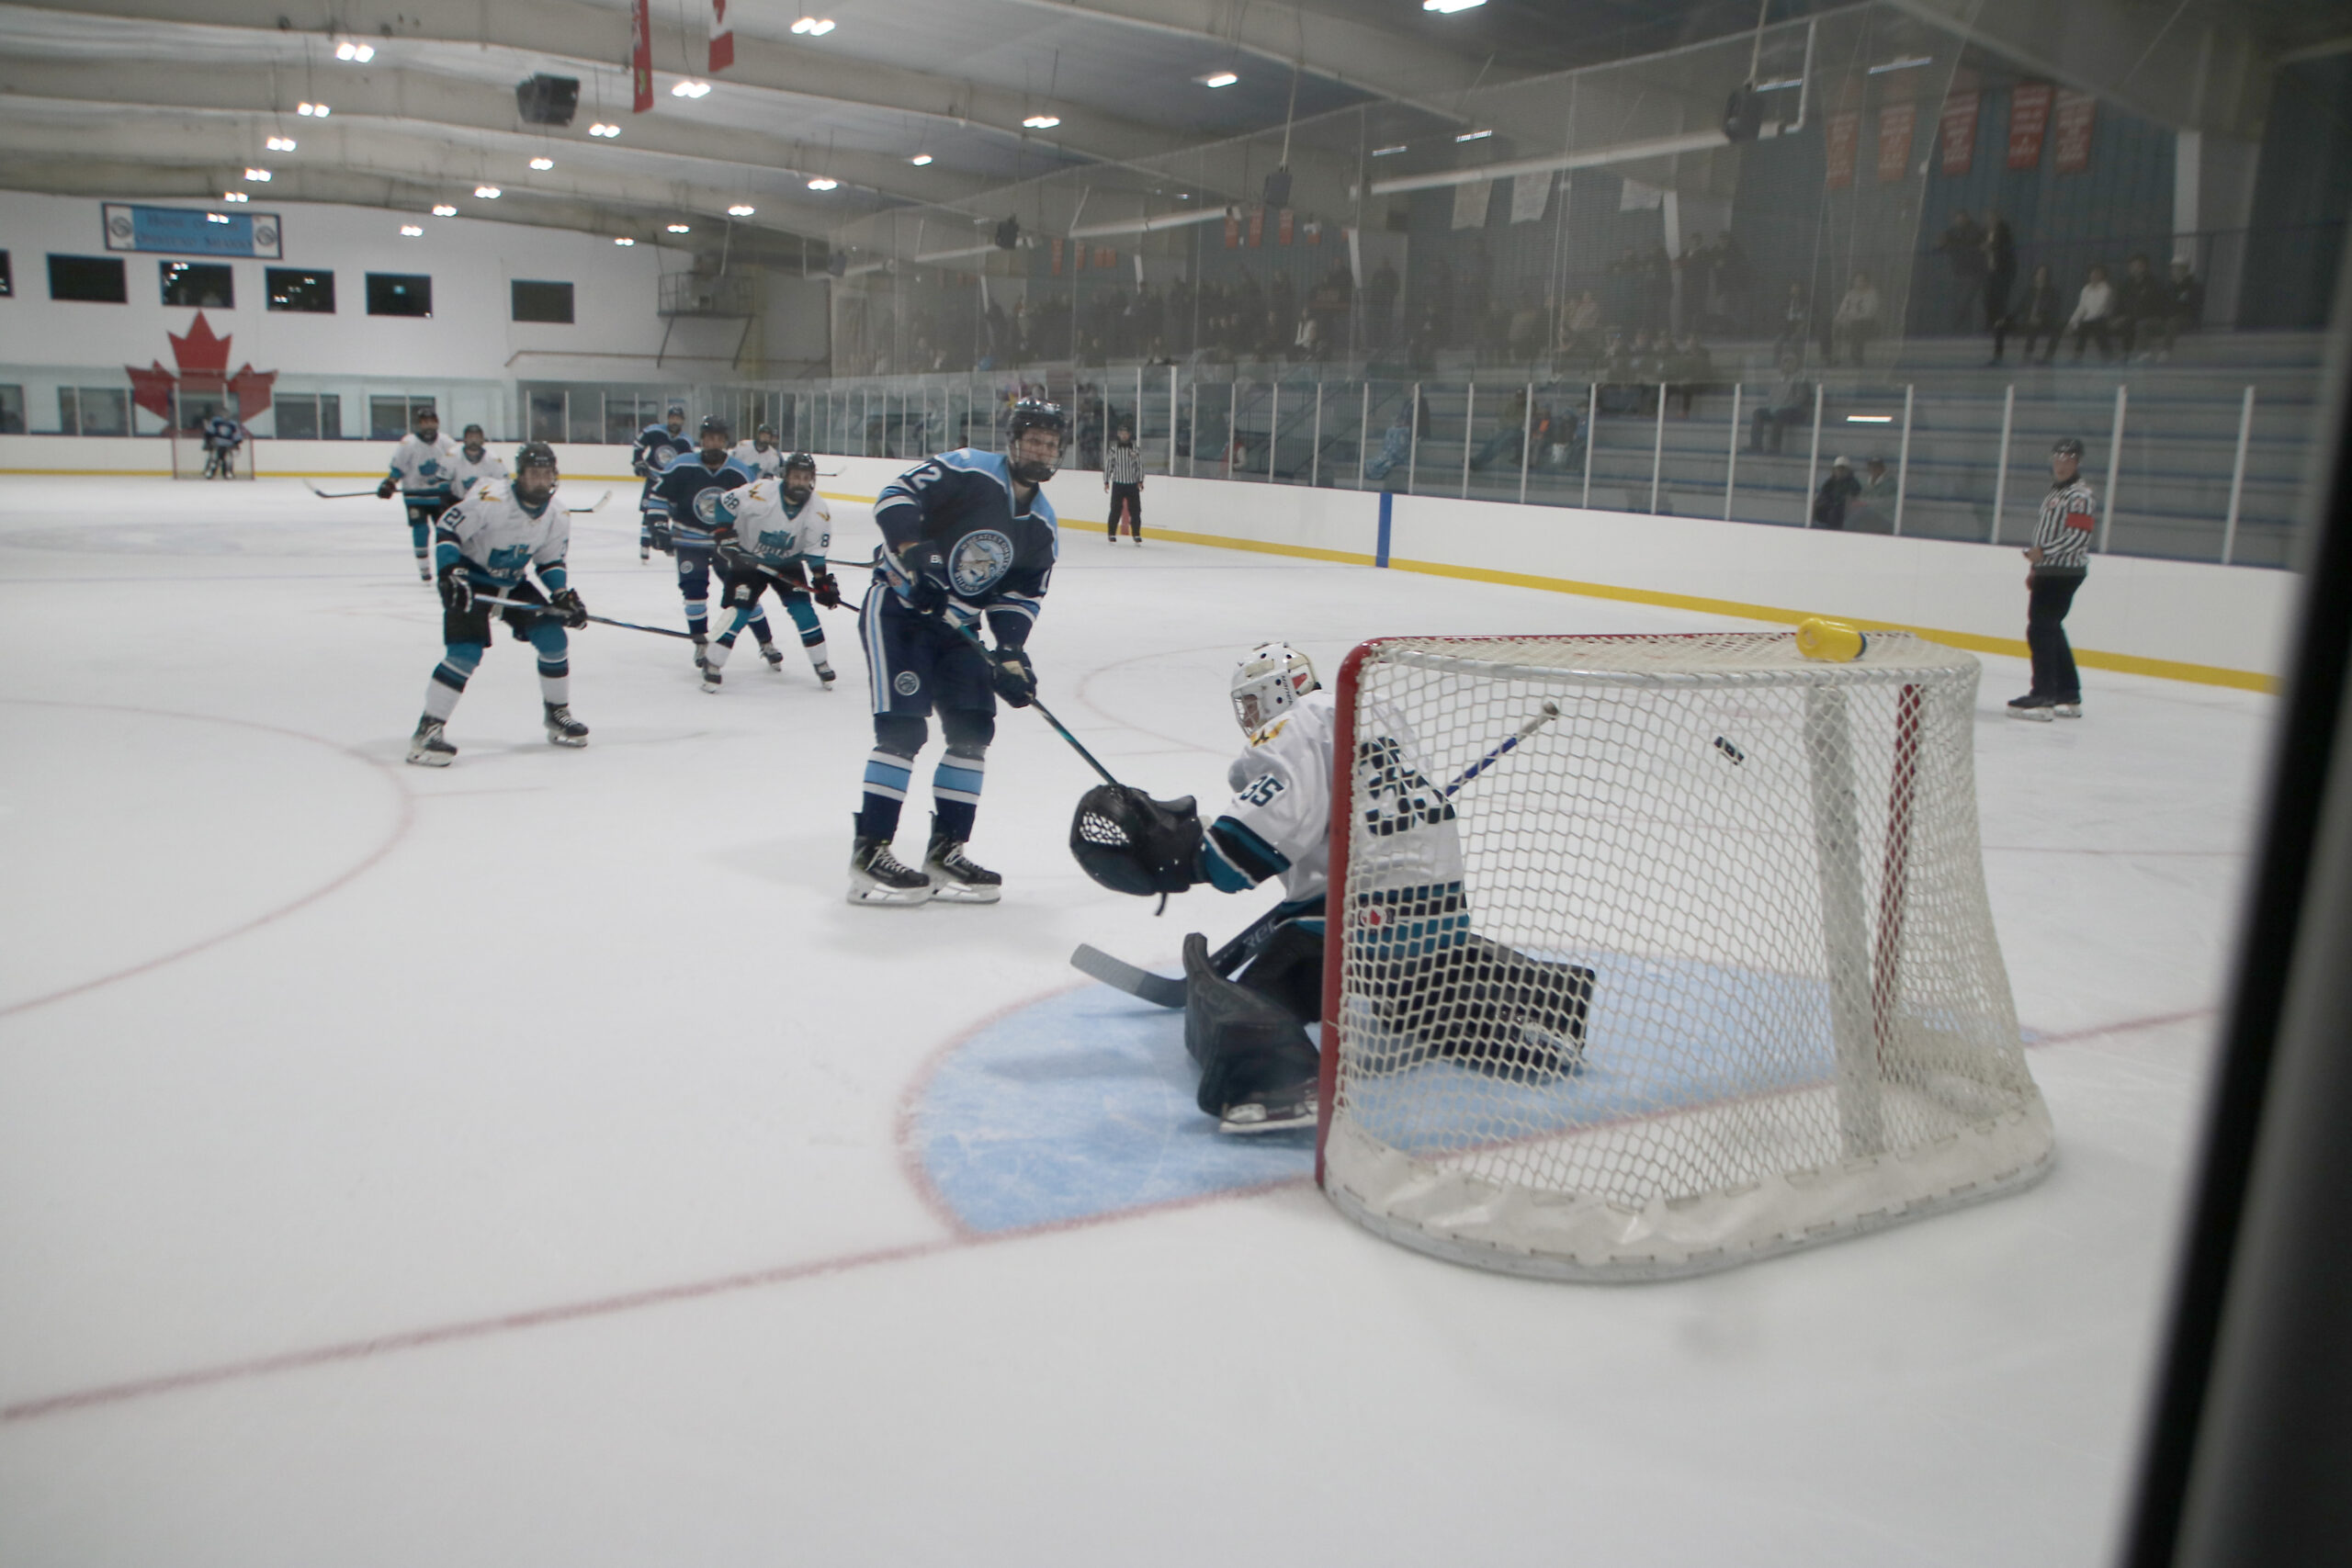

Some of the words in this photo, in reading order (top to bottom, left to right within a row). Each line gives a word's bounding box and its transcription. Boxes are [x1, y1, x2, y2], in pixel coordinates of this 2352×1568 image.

[904, 462, 942, 491] 12
[443, 507, 466, 527] 21
[1239, 774, 1284, 807] 35
